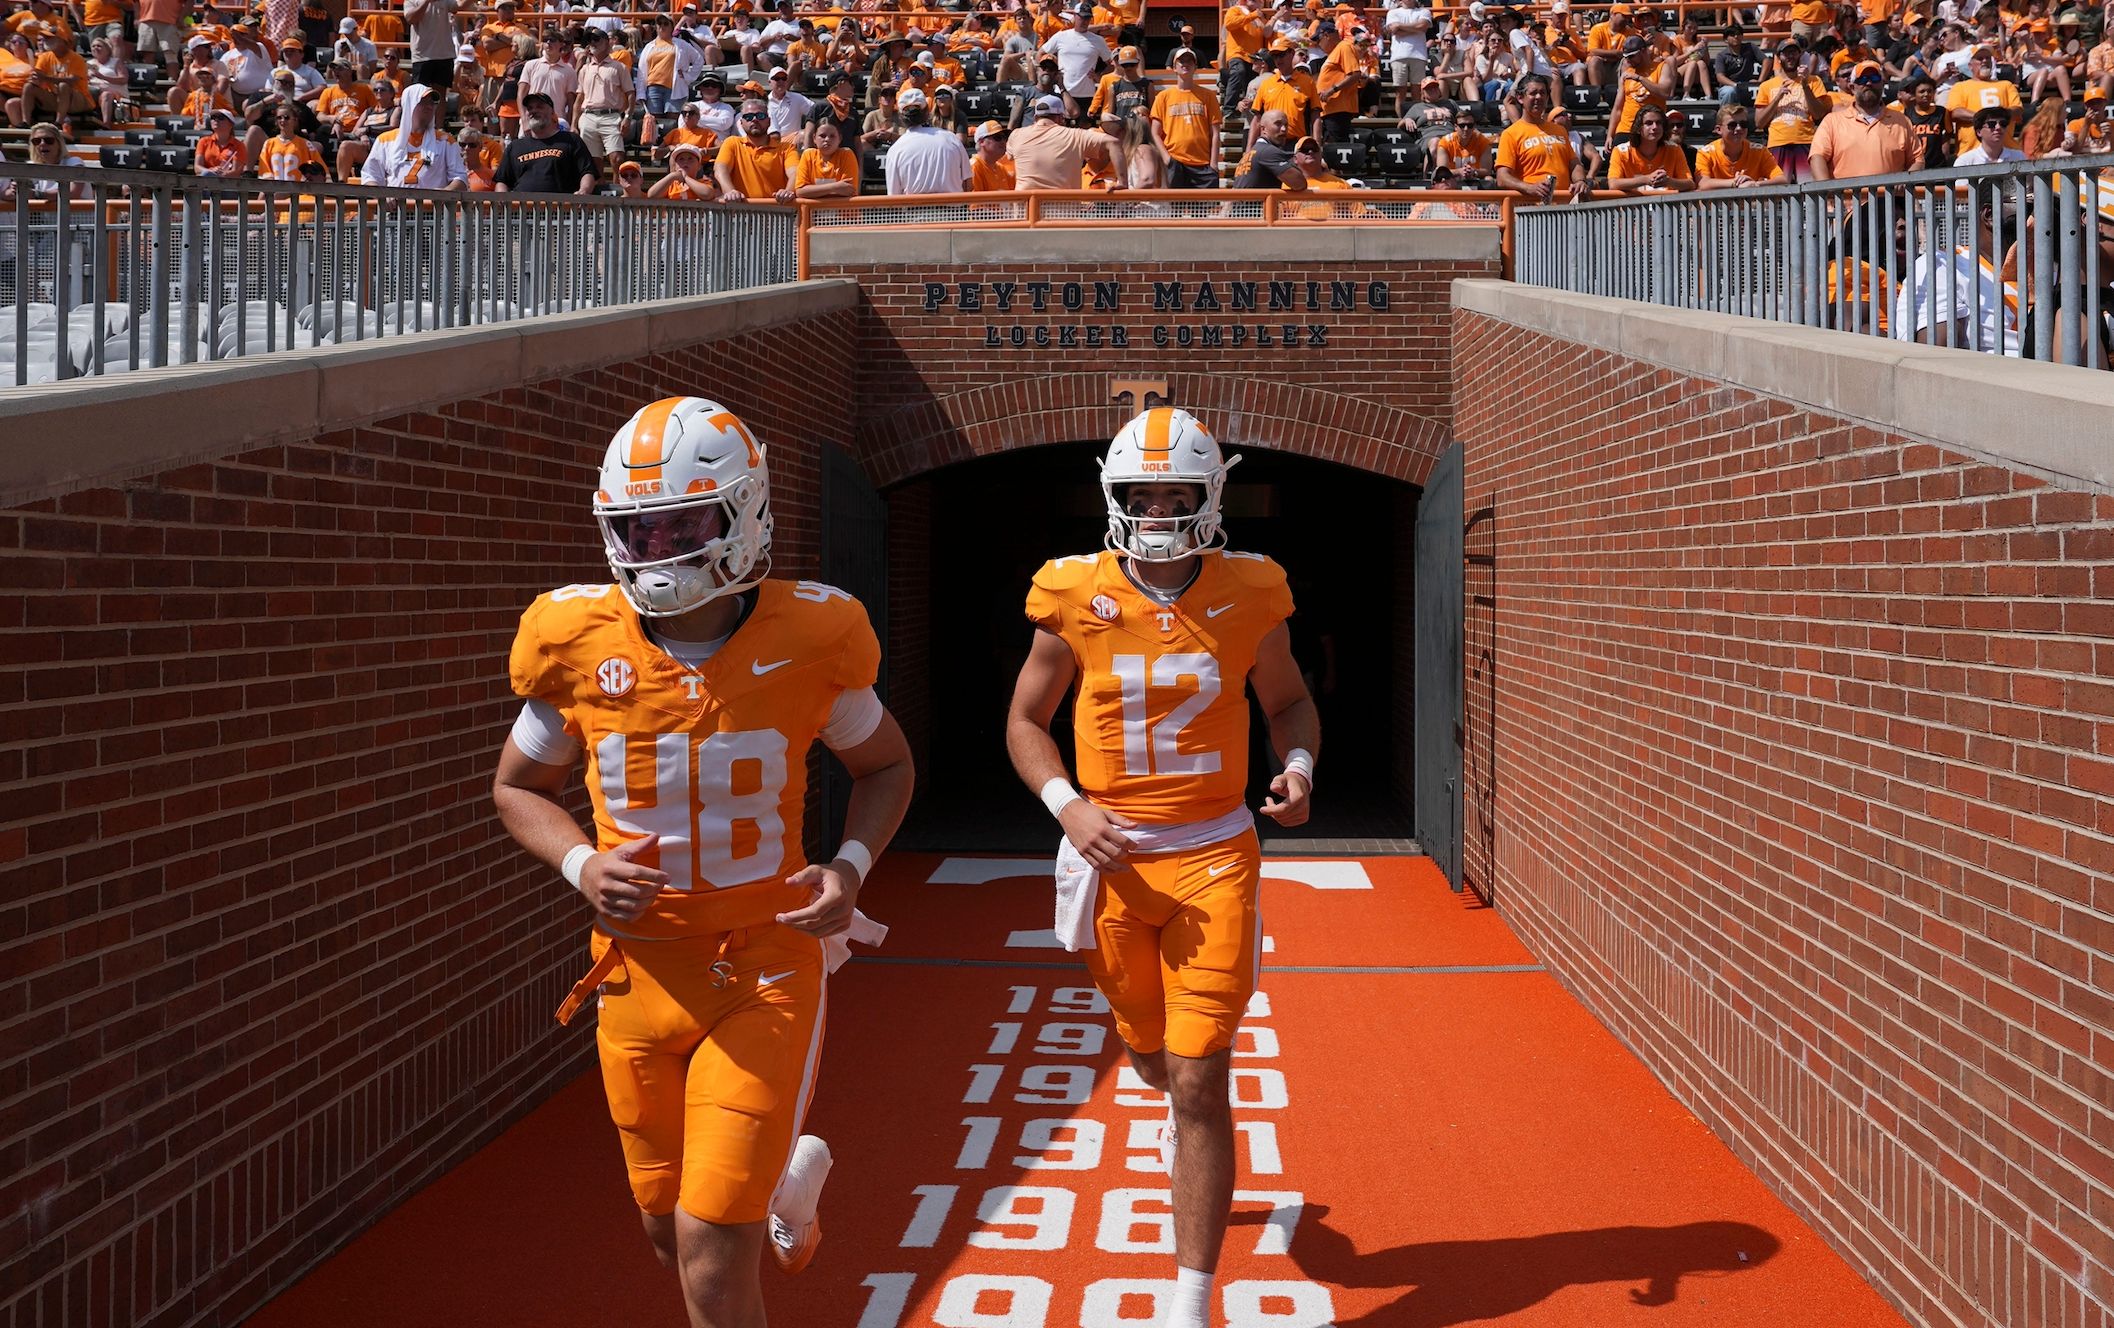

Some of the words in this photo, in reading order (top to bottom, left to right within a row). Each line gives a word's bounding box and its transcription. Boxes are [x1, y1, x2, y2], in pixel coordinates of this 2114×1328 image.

[134, 69, 148, 81] T
[815, 74, 828, 87] T
[967, 96, 981, 109] T
[1575, 89, 1589, 103] T
[1979, 88, 2000, 108] 6
[1689, 114, 1703, 128] T
[139, 134, 153, 149] T
[185, 135, 200, 149] T
[1524, 136, 1540, 149] GO
[114, 150, 130, 165] T
[160, 150, 176, 165] T
[518, 148, 563, 163] TENNESSEE
[1336, 148, 1352, 164] T
[1390, 148, 1406, 164] T
[271, 153, 299, 180] 92
[404, 152, 425, 184] 7
[924, 281, 1121, 311] PEYTON
[1152, 281, 1391, 311] MANNING
[985, 325, 1130, 347] LOCKER
[1152, 325, 1328, 347] COMPLEX
[1110, 379, 1168, 419] T
[707, 412, 761, 469] T
[1142, 463, 1170, 472] VOLS
[624, 482, 661, 497] VOLS
[699, 479, 708, 490] T
[1092, 594, 1118, 619] SEC
[1156, 612, 1175, 631] T
[597, 658, 632, 695] SEC
[680, 675, 705, 699] T
[1111, 653, 1222, 776] 12
[598, 728, 789, 890] 48
[987, 1022, 1281, 1058] 190
[899, 1184, 1303, 1256] 1967
